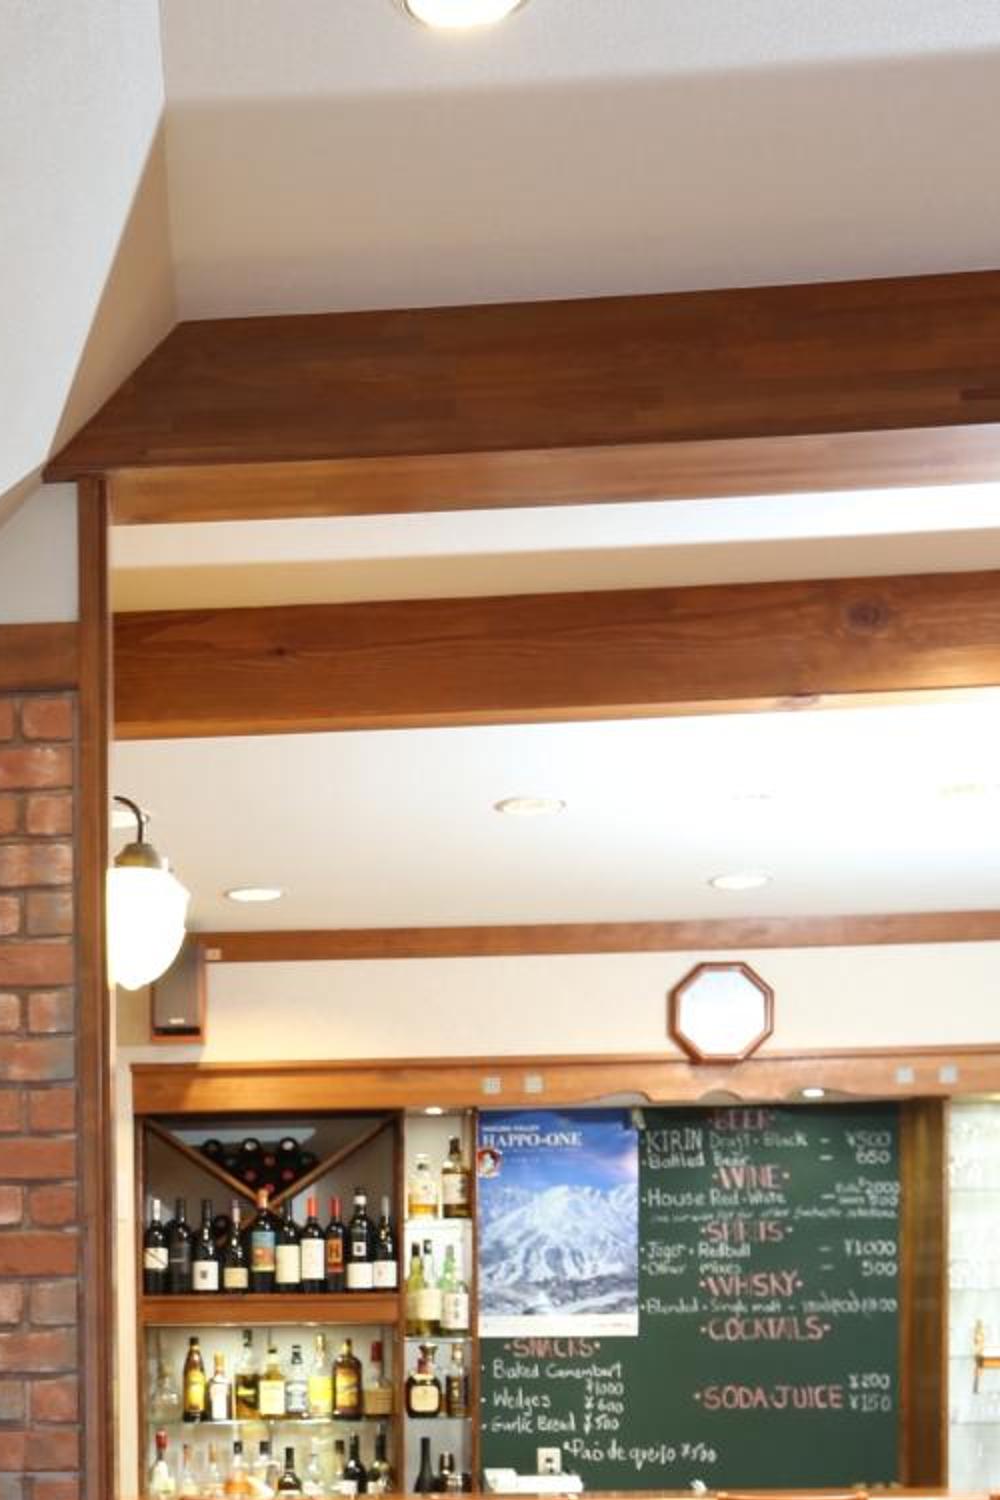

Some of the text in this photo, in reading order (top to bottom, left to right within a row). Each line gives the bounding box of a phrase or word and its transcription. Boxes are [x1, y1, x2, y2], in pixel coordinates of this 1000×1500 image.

[482, 1131, 583, 1147] HAPPO-ONE
[646, 1127, 703, 1153] KIRIN
[647, 1187, 706, 1207] House
[861, 1260, 898, 1277] 500
[493, 1358, 539, 1379] Baked
[493, 1387, 552, 1416] Wedges
[704, 1385, 768, 1410] SODA
[770, 1385, 844, 1409] JUICE
[607, 1437, 627, 1460] de
